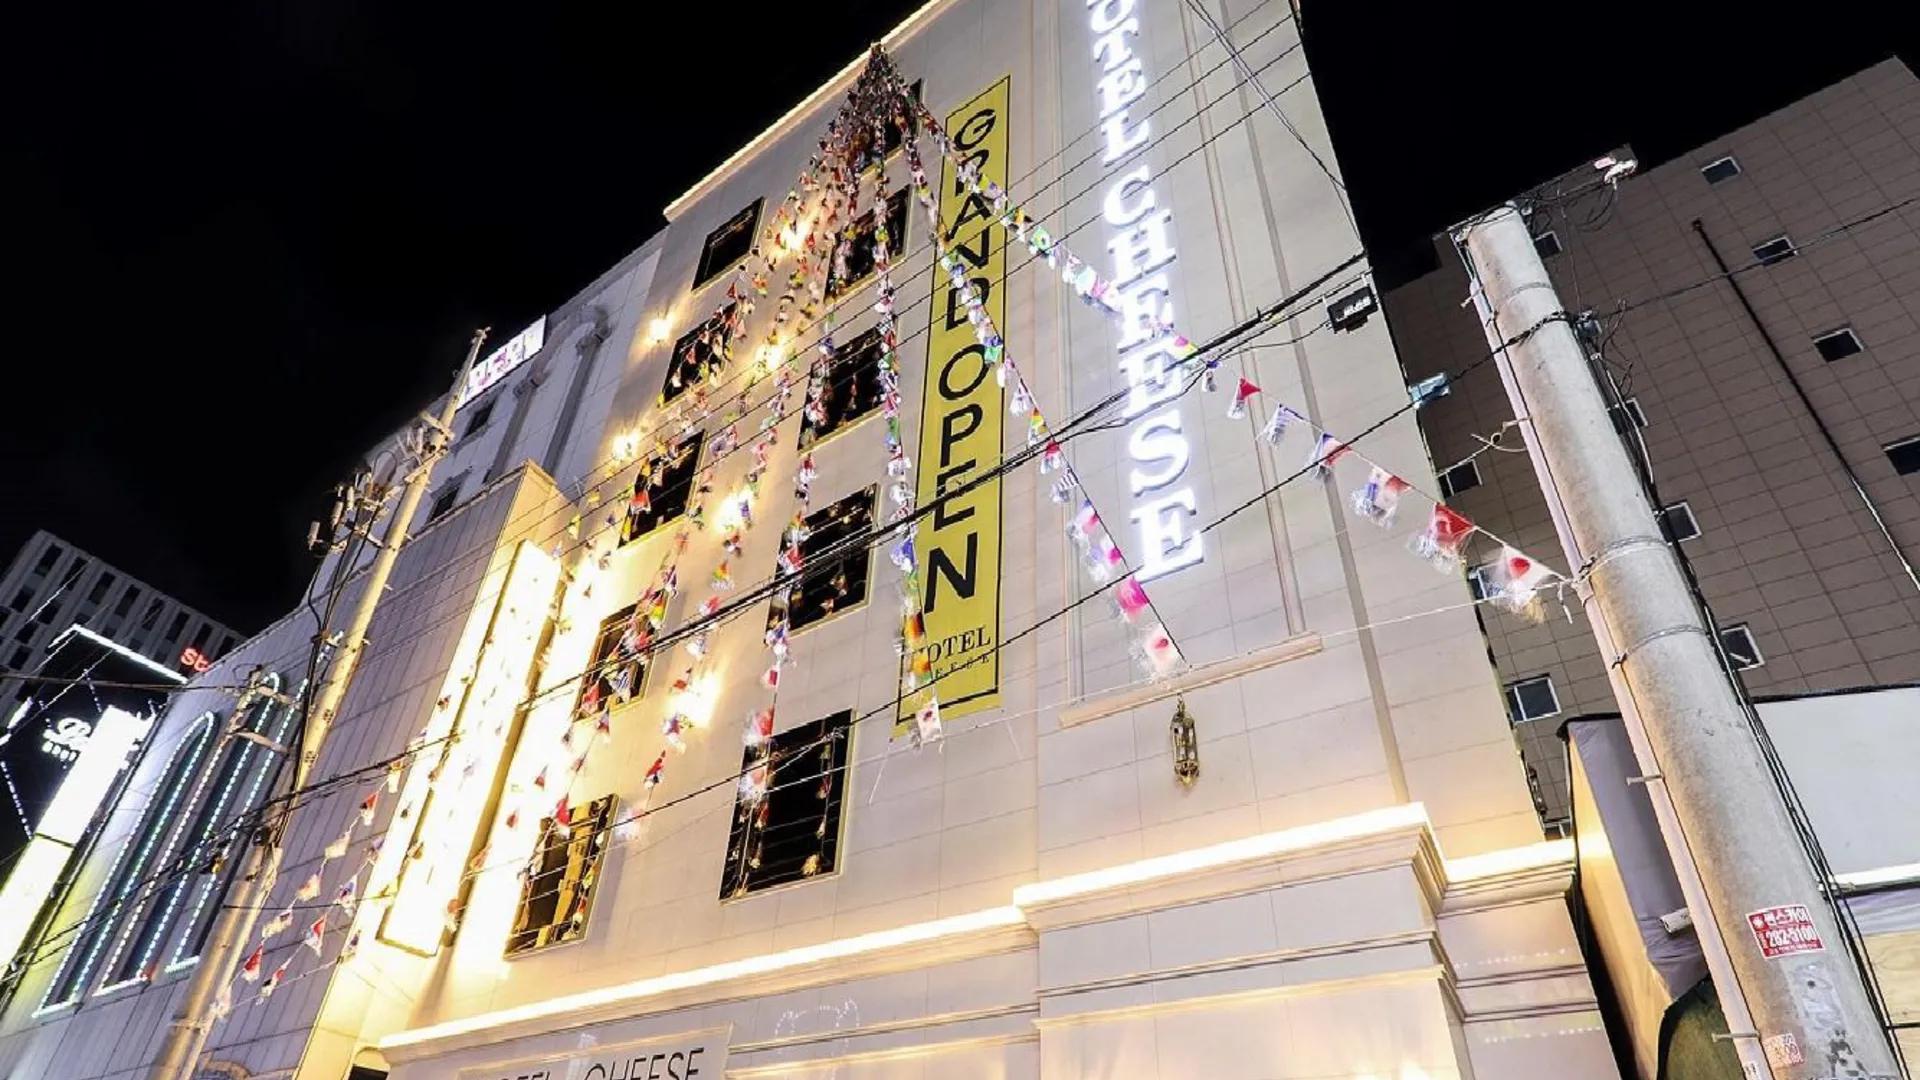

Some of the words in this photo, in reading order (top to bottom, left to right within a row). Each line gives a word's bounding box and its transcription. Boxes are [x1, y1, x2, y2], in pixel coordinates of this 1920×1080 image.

[1086, 0, 1149, 167] OTEL
[924, 343, 990, 614] OPEN
[1104, 165, 1204, 583] CHEESE
[912, 626, 991, 664] OTEL
